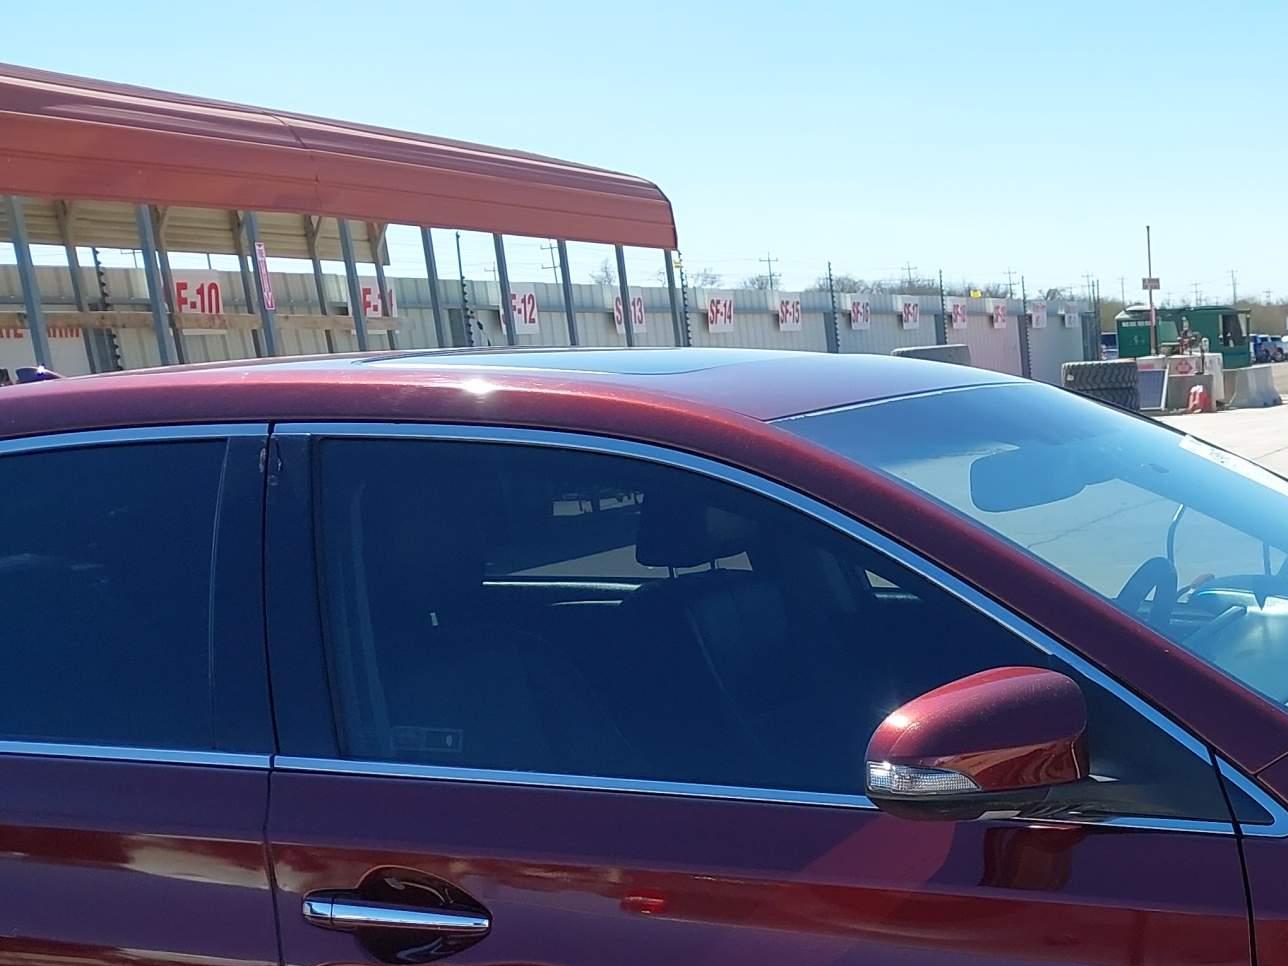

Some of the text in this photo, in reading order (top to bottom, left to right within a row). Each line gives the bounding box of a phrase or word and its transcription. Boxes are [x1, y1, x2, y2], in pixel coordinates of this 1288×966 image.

[163, 281, 221, 314] F-10
[502, 293, 536, 324] F-12
[615, 296, 644, 325] S13
[709, 299, 733, 325] SF-14
[780, 300, 800, 324] SF-15
